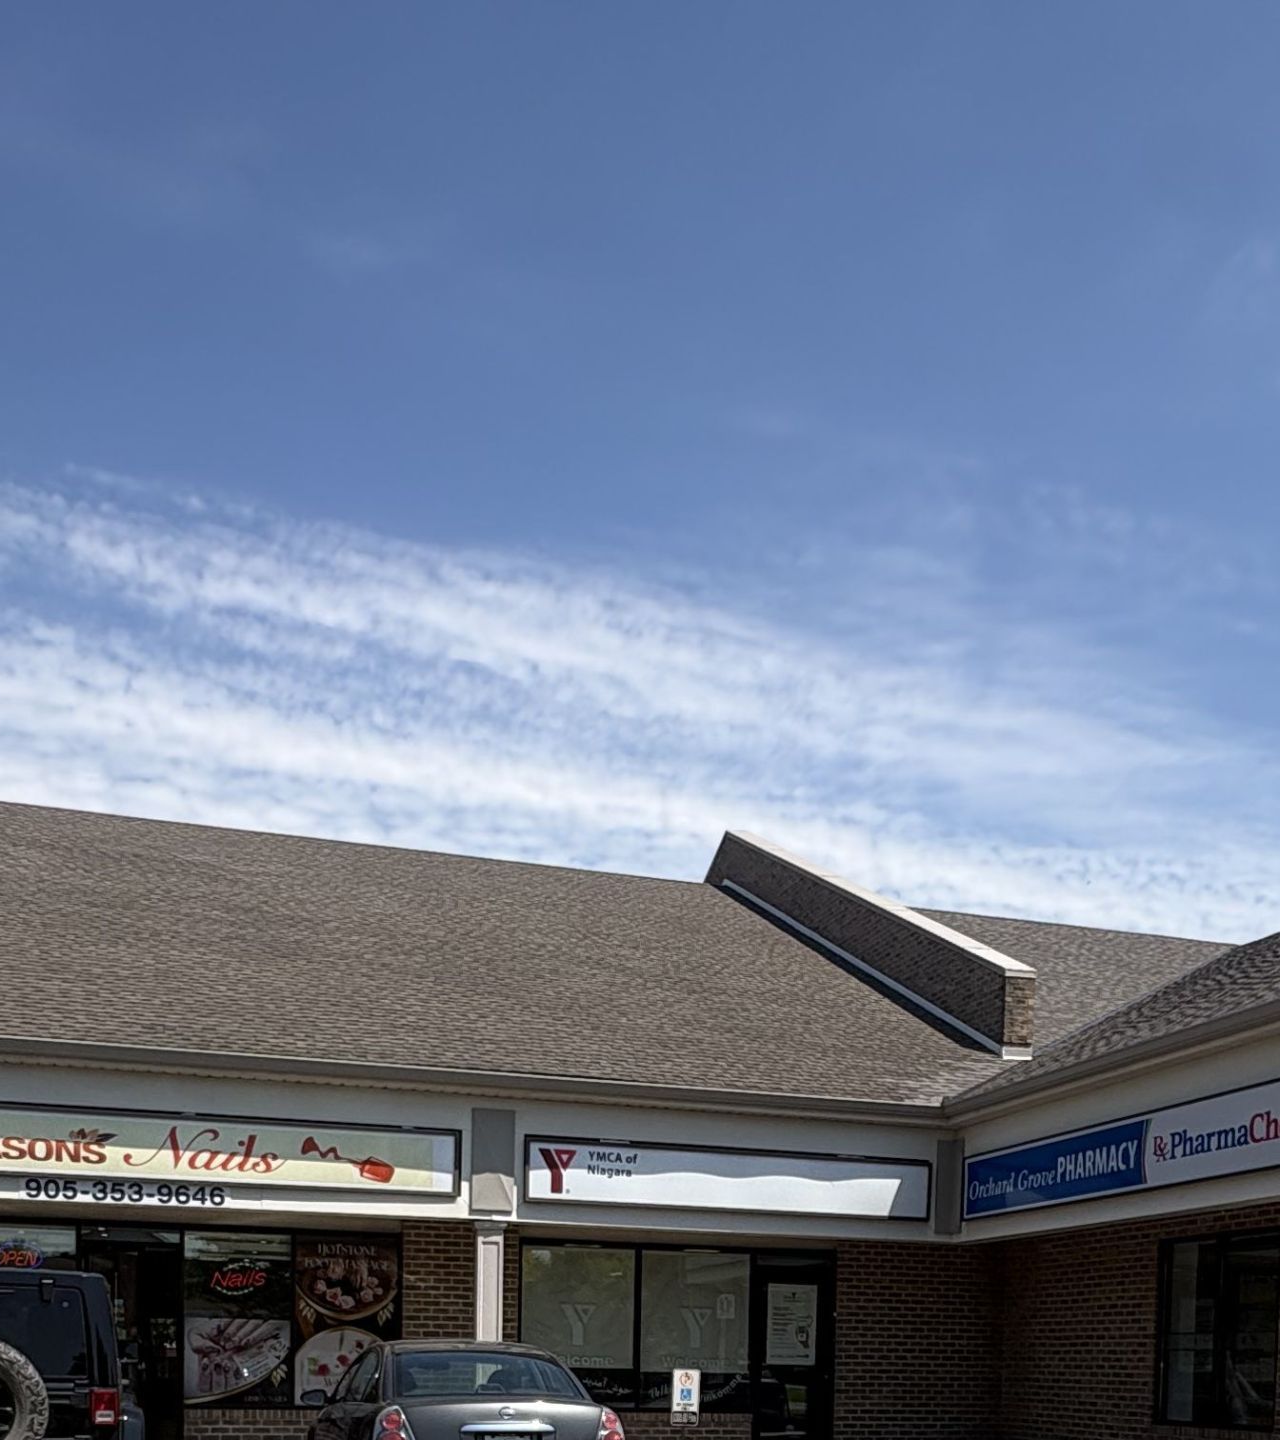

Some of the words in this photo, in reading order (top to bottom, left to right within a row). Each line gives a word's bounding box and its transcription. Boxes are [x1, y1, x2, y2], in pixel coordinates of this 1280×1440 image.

[124, 1126, 286, 1175] Nails
[587, 1150, 623, 1165] YMCA
[625, 1152, 639, 1166] of
[587, 1163, 633, 1179] Niagara
[969, 1169, 1015, 1200] Orchard
[1018, 1168, 1056, 1192] Grove
[1056, 1139, 1139, 1184] PHARMACY
[24, 1178, 226, 1207] 905-353-9646
[209, 1269, 268, 1289] Nails
[558, 1354, 614, 1367] elcome
[662, 1354, 730, 1369] Welcome
